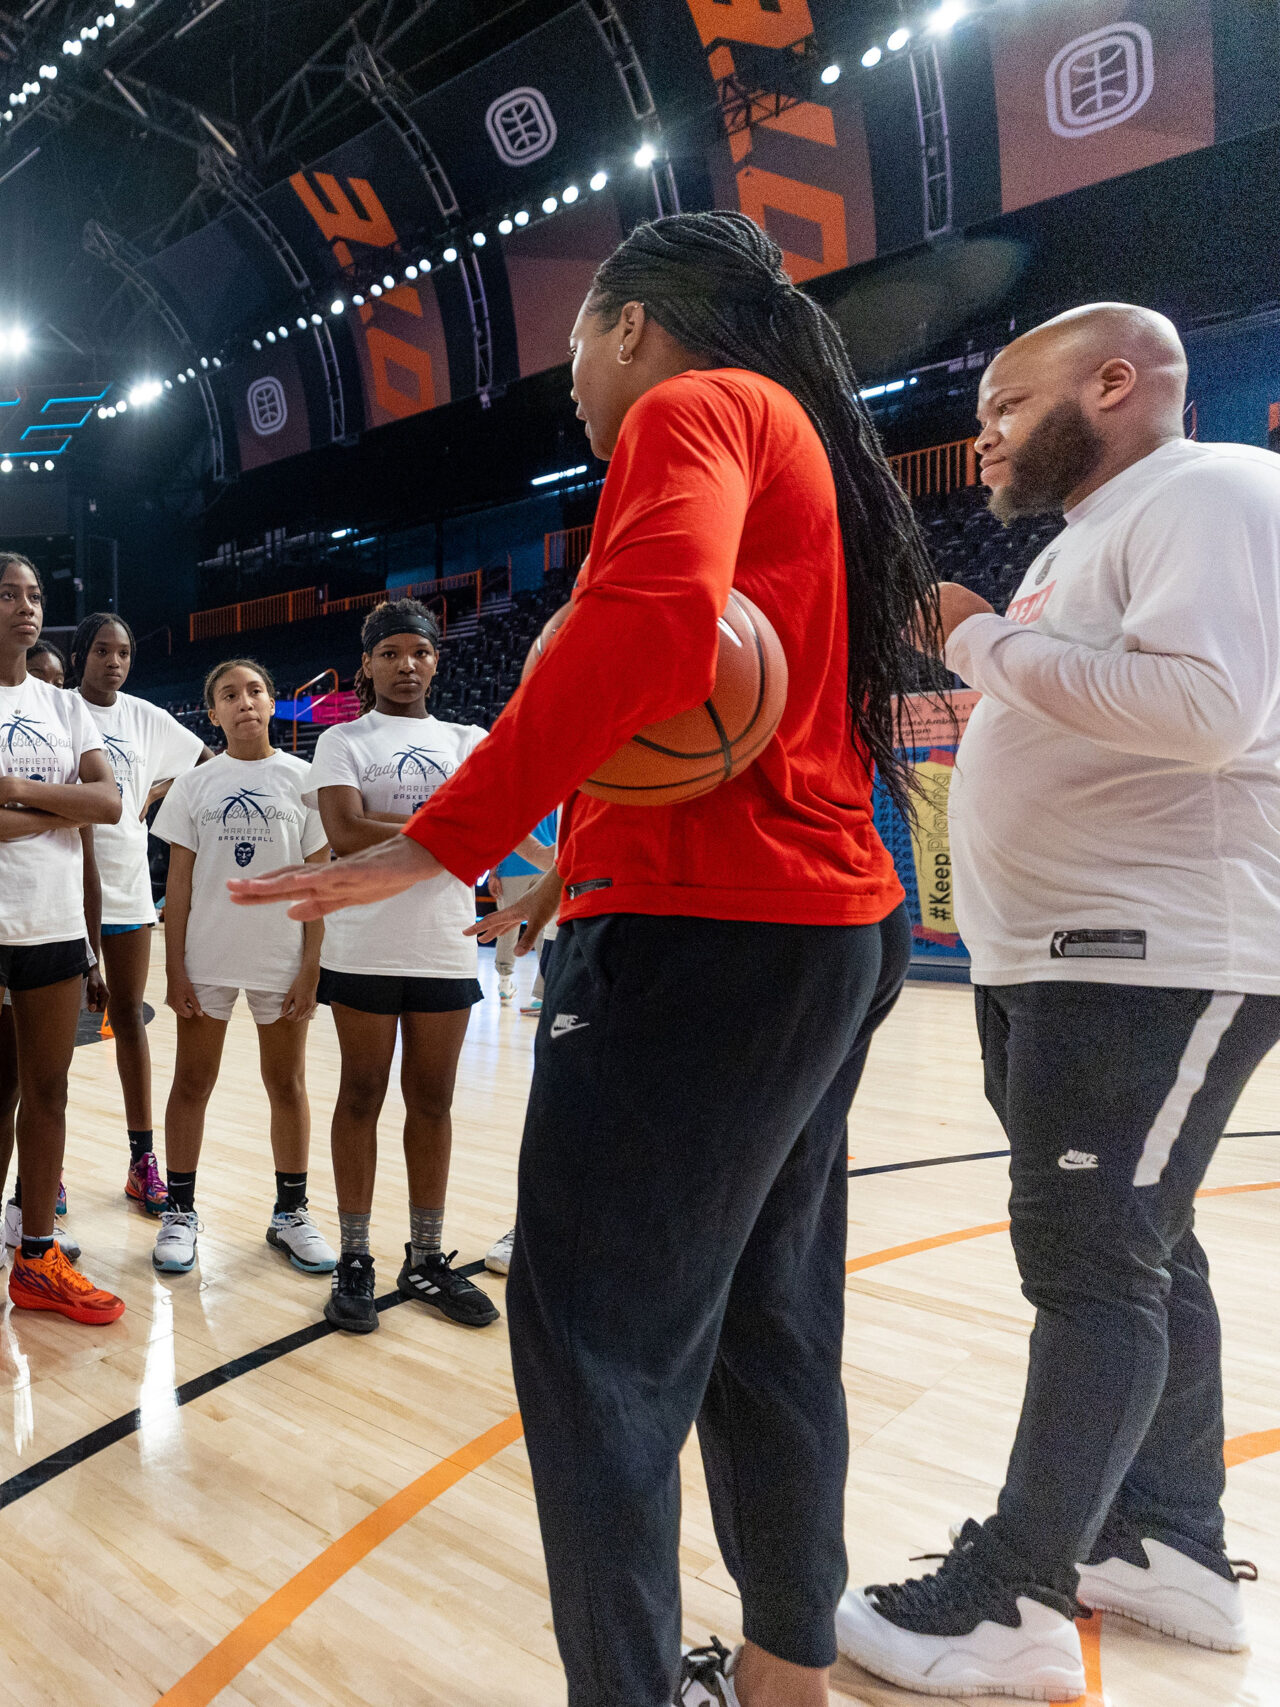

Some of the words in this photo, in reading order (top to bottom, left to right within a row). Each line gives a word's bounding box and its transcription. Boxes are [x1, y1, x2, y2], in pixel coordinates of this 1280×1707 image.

[11, 757, 59, 766] MARIETTA
[7, 766, 62, 774] BASKETBALL
[361, 761, 399, 783] Lady
[401, 760, 436, 776] Blue
[227, 804, 260, 820] Blue
[222, 827, 271, 835] MARIETTA
[218, 835, 274, 843] BASKETBALL
